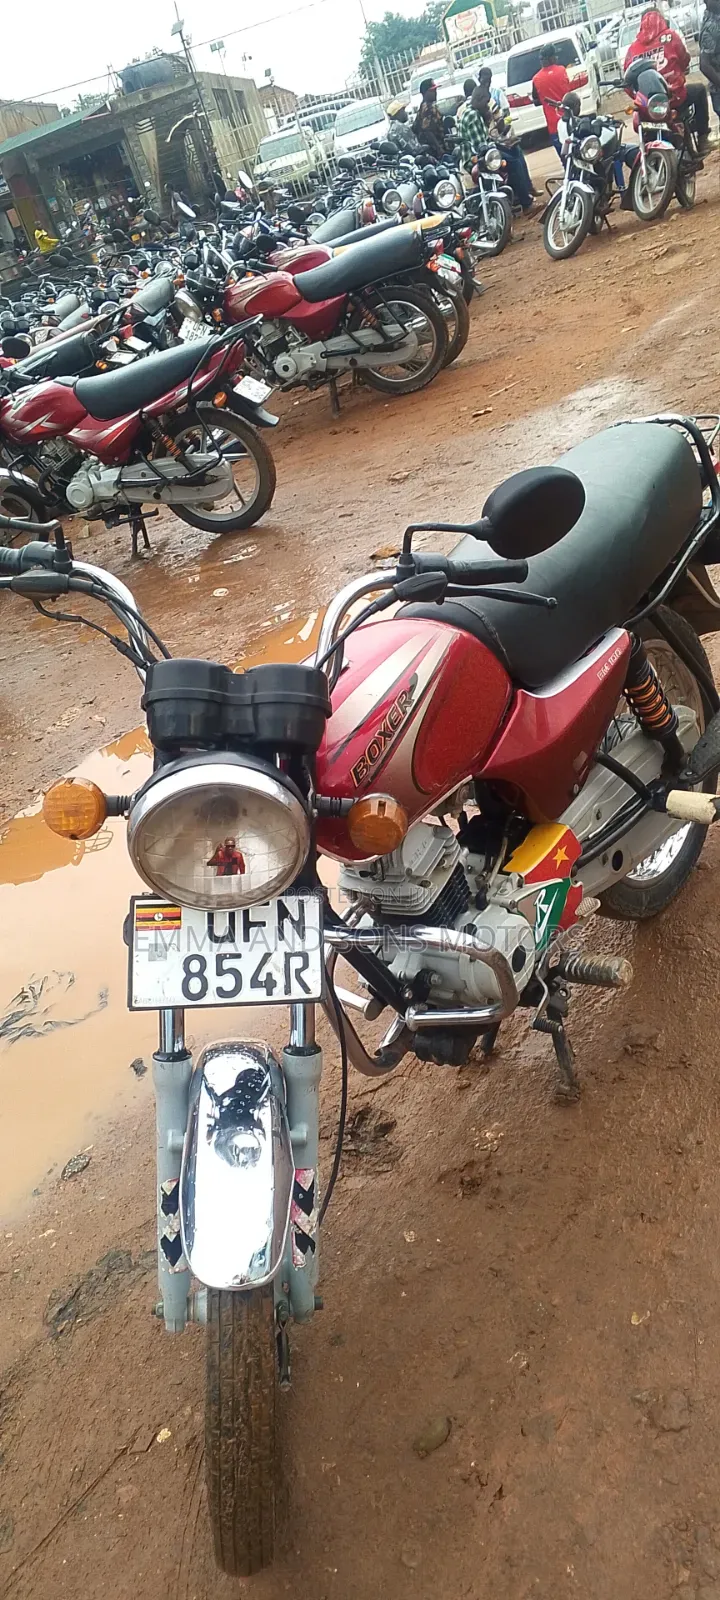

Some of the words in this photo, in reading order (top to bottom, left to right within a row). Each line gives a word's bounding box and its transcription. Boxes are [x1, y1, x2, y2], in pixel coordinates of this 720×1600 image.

[350, 689, 415, 789] BOXER
[207, 899, 306, 943] UFN
[181, 952, 312, 1000] 854R
